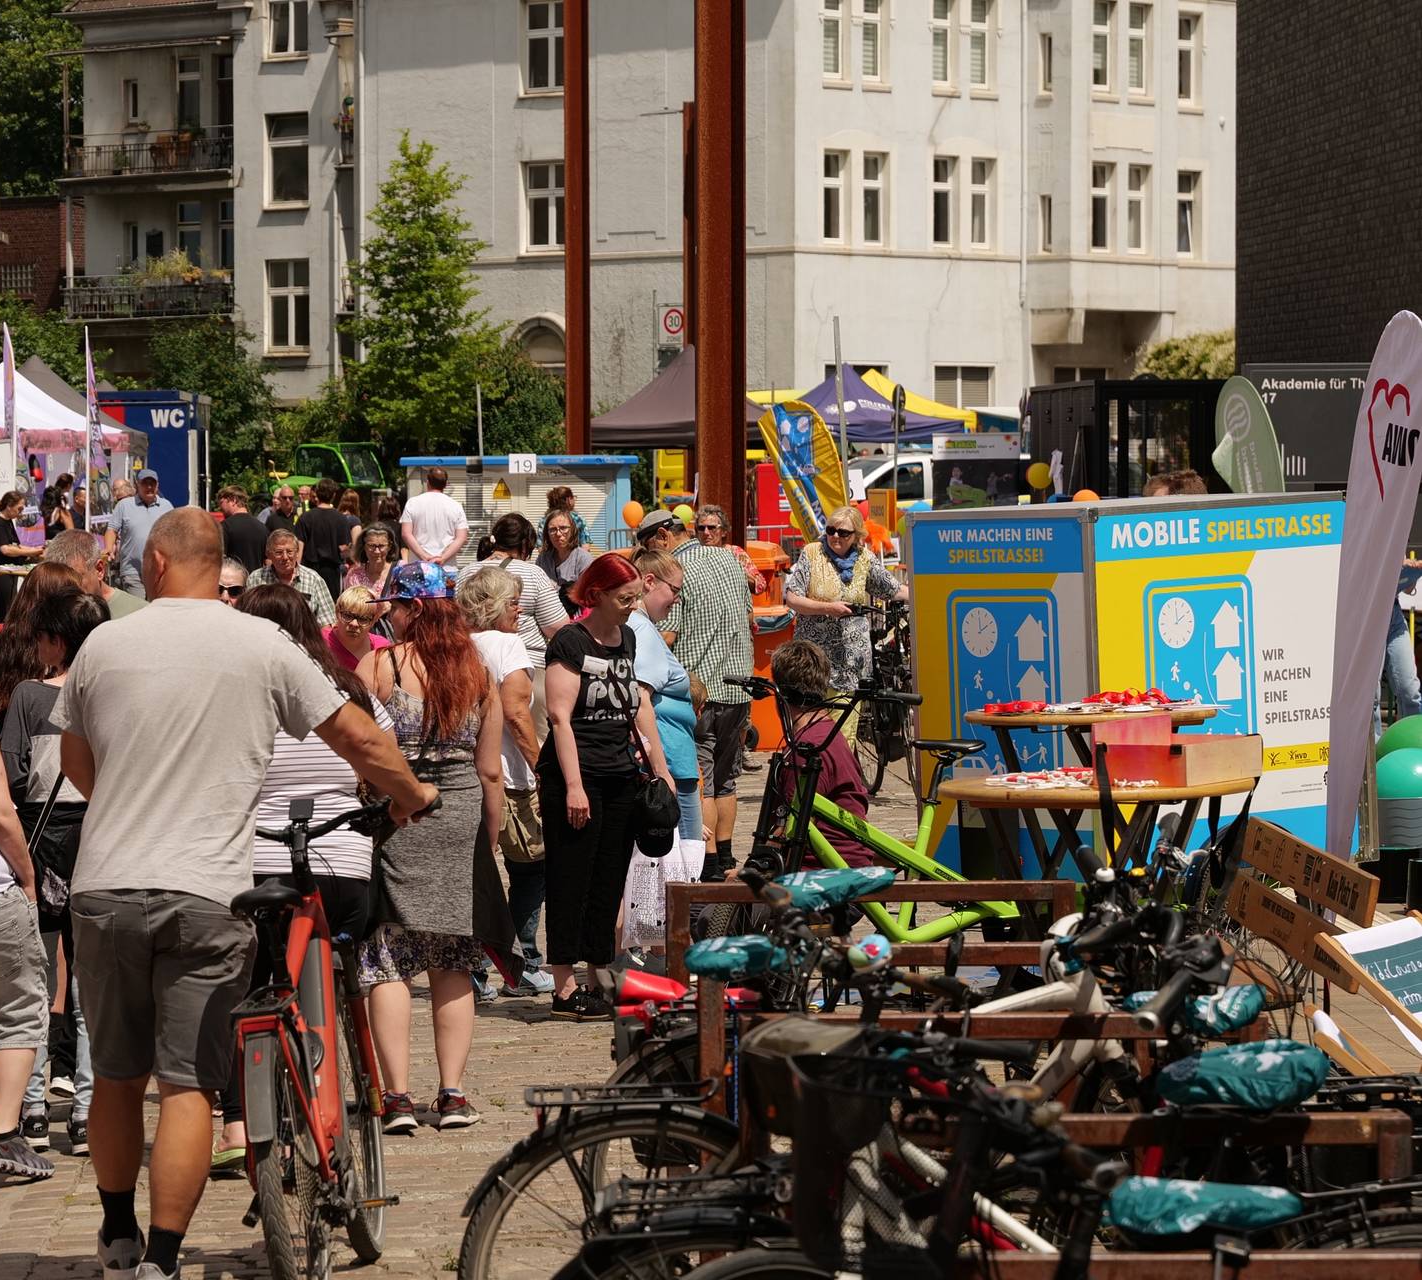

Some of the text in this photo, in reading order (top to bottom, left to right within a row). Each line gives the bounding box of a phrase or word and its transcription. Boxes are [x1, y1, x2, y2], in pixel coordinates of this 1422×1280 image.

[668, 315, 680, 327] 30
[1261, 377, 1365, 390] Akademie für Th
[1261, 392, 1277, 403] 17
[150, 408, 185, 428] WC
[514, 460, 532, 473] 19
[938, 527, 1053, 543] WIR MACHEN EINE
[1111, 514, 1332, 549] MOBILE SPIELSTRASSE
[948, 547, 1044, 563] SPIELSTRASSE!
[1262, 648, 1284, 661] WIR
[1263, 666, 1311, 682] MACHEN
[1264, 690, 1288, 703] EINE
[1264, 706, 1331, 725] SPIELSTRASS
